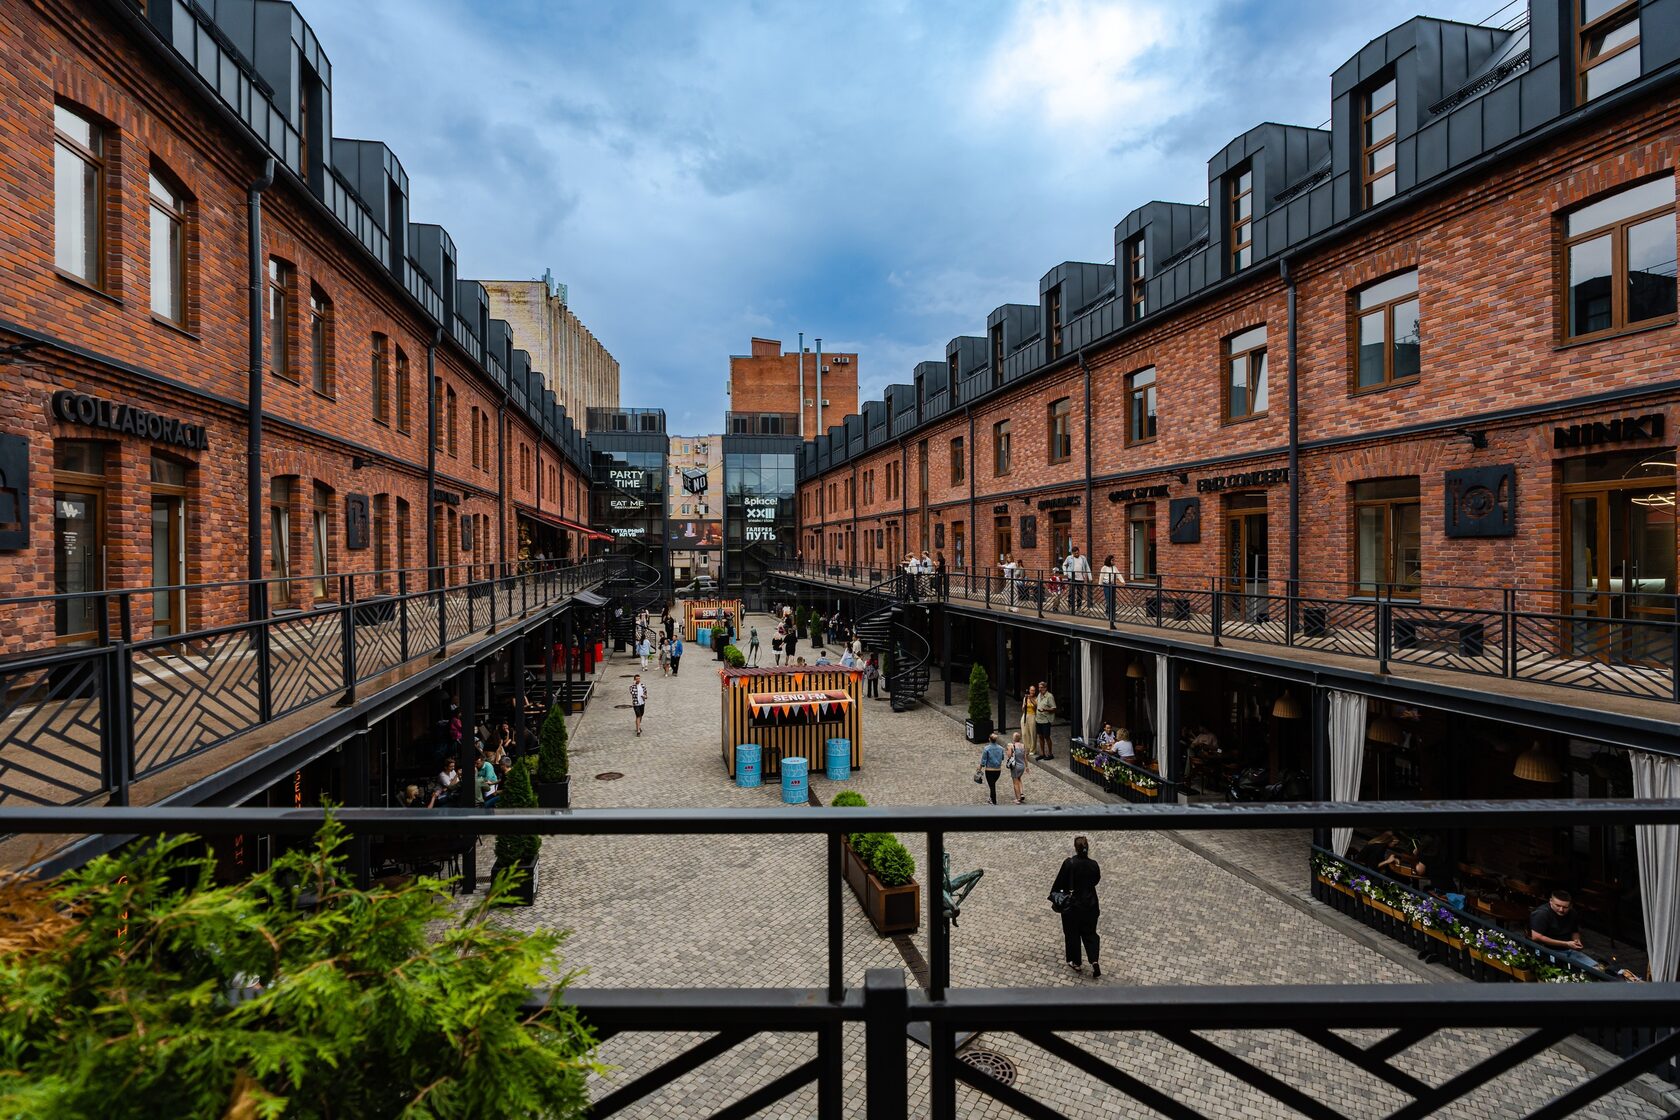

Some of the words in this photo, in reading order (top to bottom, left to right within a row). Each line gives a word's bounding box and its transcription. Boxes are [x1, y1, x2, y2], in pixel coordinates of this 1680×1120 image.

[1554, 413, 1665, 449] NINKI
[610, 470, 644, 478] PARTY
[615, 480, 640, 488] TIME
[746, 508, 775, 518] XXIII
[746, 532, 776, 540] ПУТЬ
